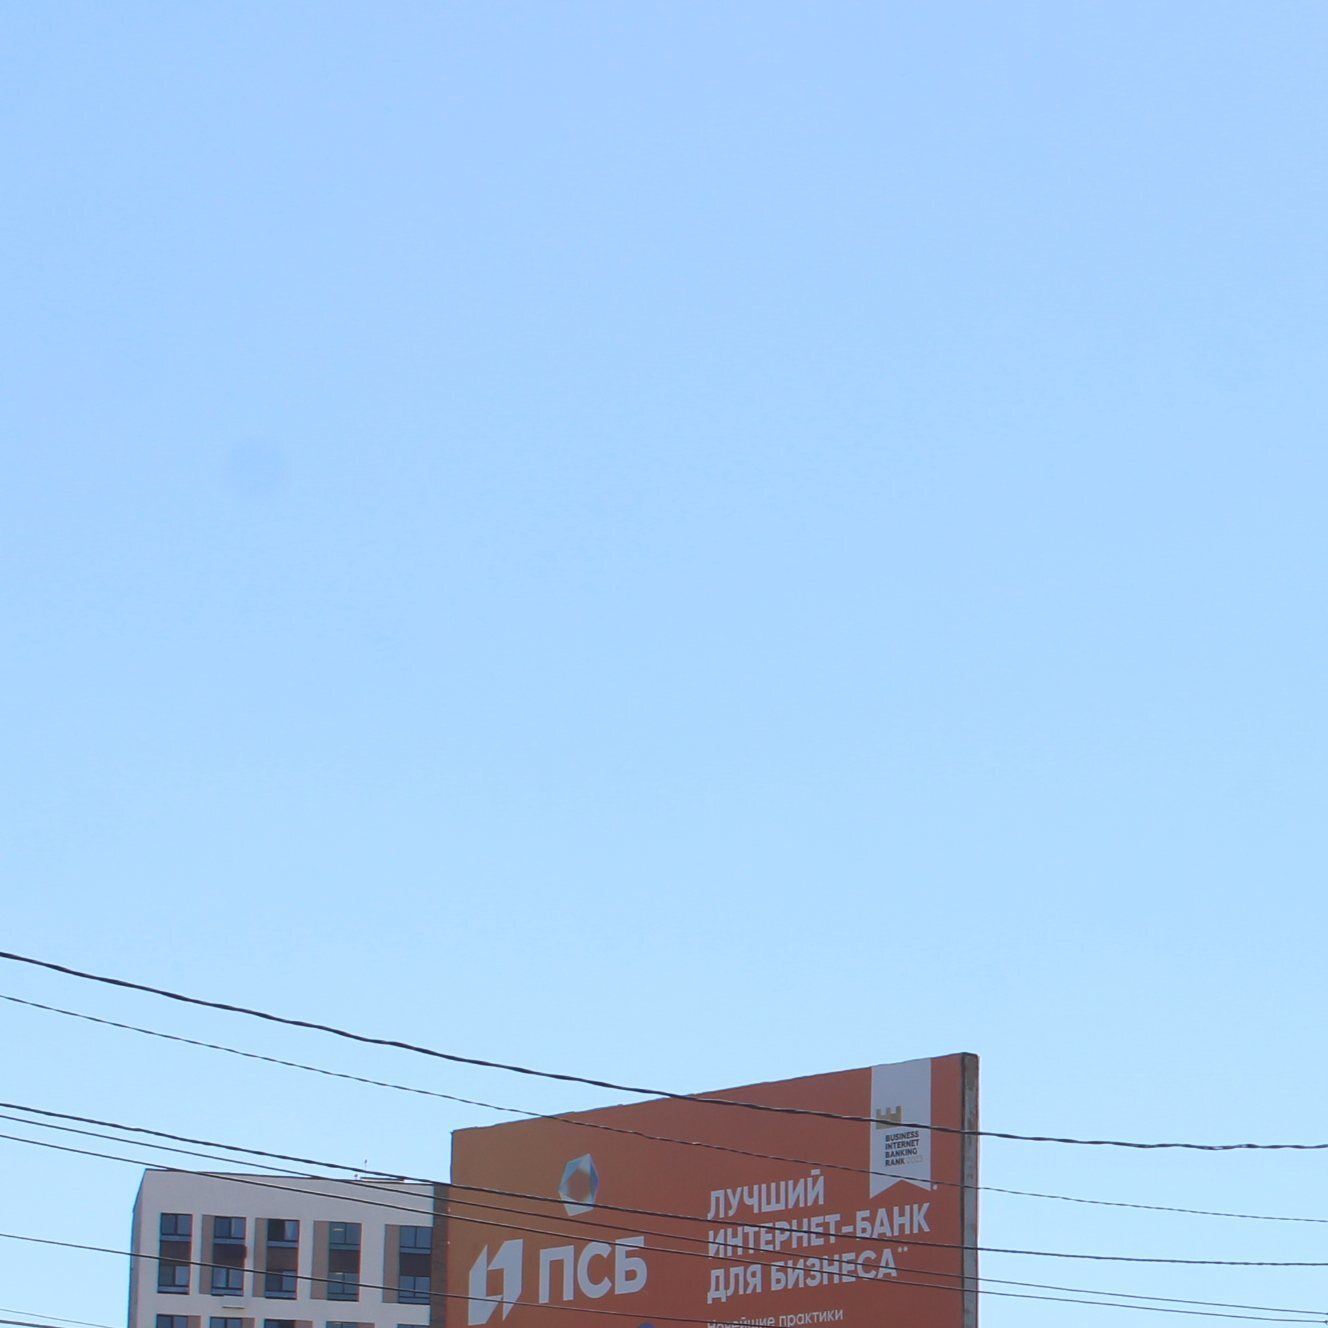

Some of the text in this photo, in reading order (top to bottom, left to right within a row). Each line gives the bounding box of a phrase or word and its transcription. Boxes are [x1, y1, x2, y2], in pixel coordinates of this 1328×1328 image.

[885, 1131, 920, 1142] BUSINESS
[885, 1139, 920, 1150] INTERNET
[885, 1148, 918, 1158] BANKING
[885, 1158, 905, 1167] RANK
[707, 1168, 825, 1220] ЛУЧШИЙ
[708, 1202, 931, 1259] ИНТЕРНЕТ-БАНК
[538, 1235, 648, 1304] ПСБ
[707, 1264, 763, 1304] ДЛЯ
[778, 1309, 844, 1328] практики
